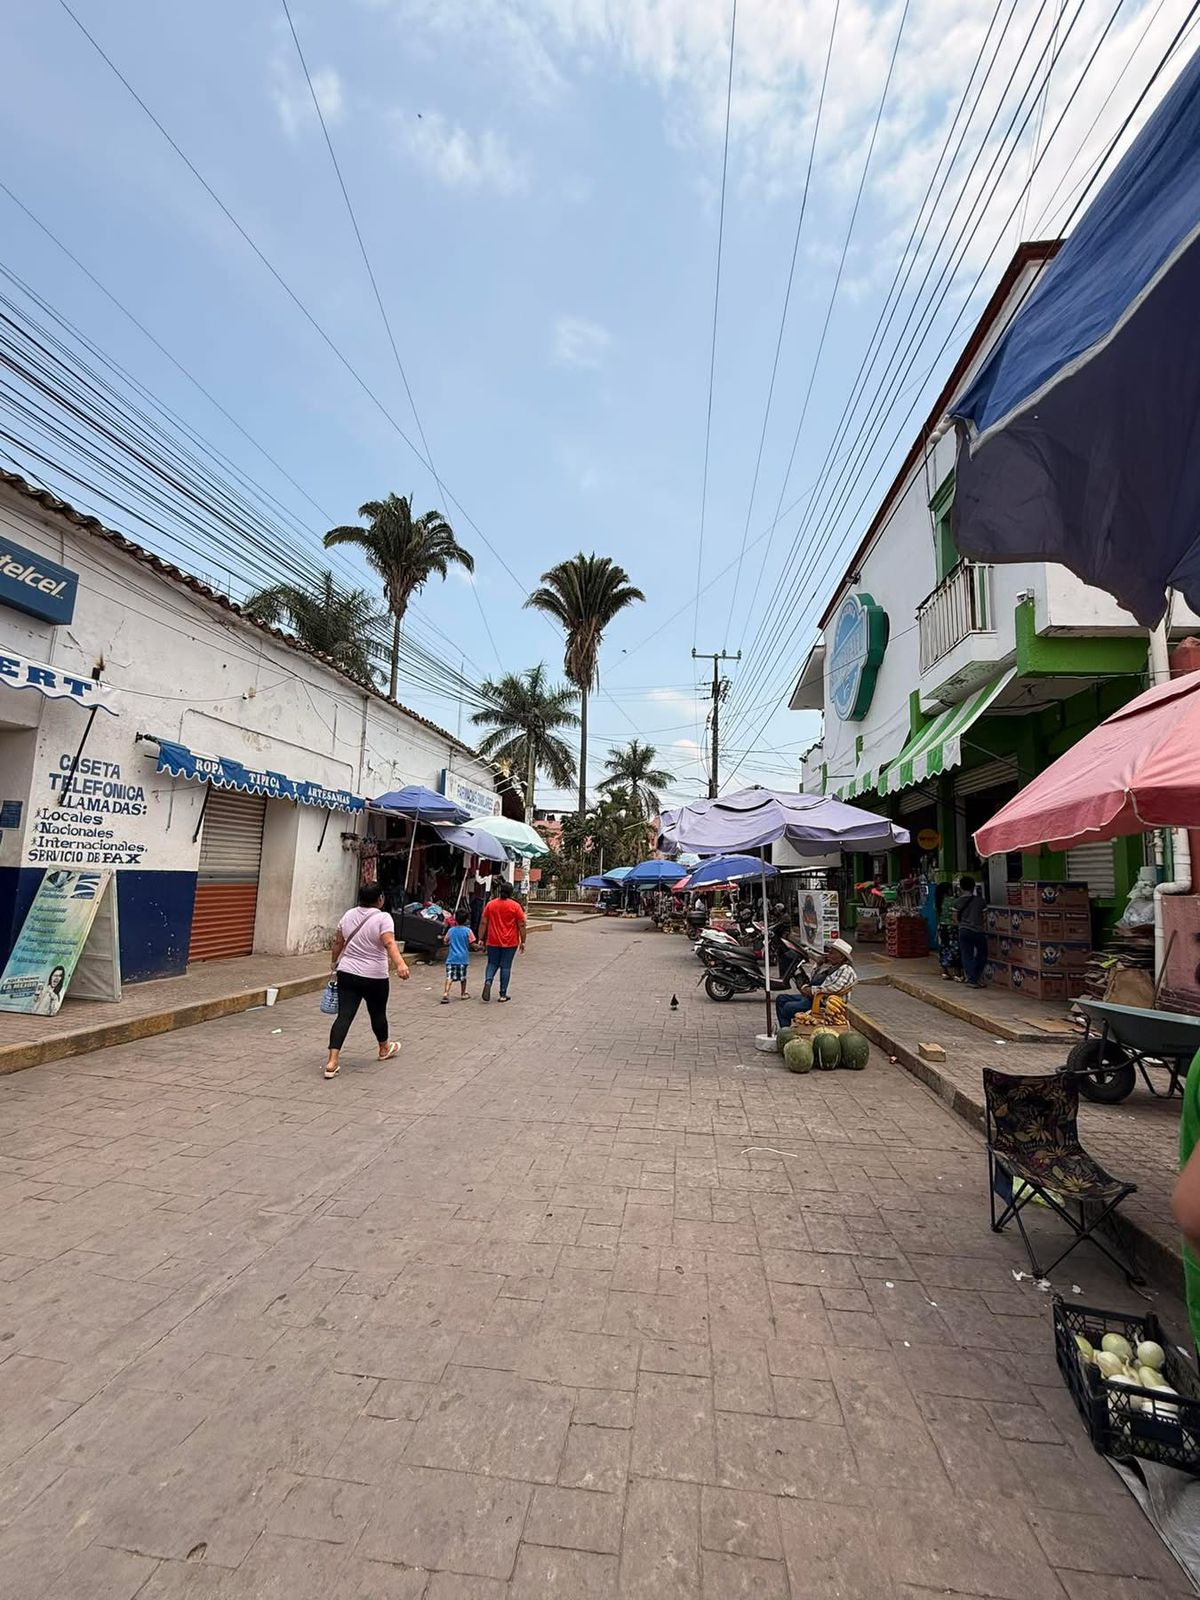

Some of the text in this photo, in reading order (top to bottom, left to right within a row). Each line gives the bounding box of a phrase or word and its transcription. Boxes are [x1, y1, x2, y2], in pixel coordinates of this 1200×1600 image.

[0, 554, 67, 598] telcel
[59, 753, 121, 780] CASETA
[195, 758, 350, 805] ROPA TIPICA Y ARTESANIAS
[49, 772, 145, 802] TELEFONICA
[28, 848, 142, 864] SERVICIO DE FAX
